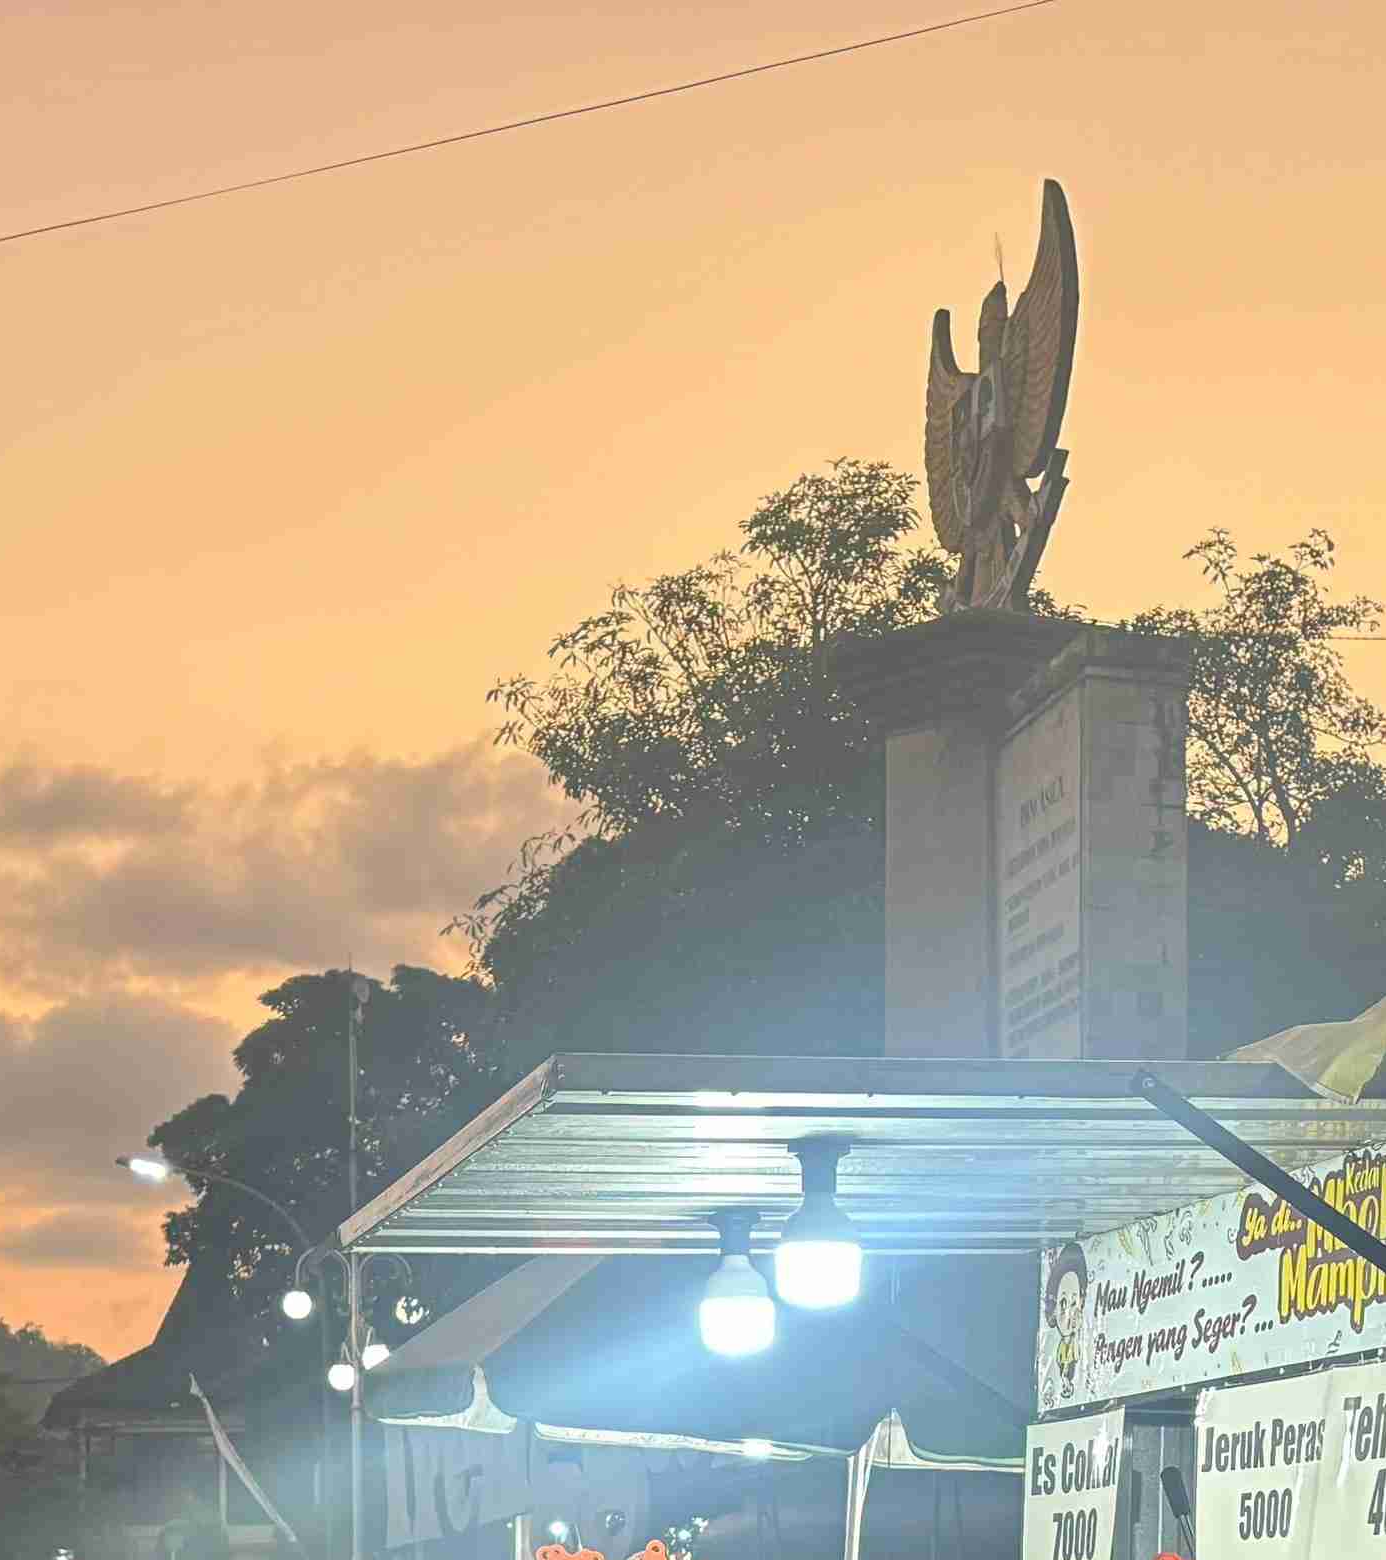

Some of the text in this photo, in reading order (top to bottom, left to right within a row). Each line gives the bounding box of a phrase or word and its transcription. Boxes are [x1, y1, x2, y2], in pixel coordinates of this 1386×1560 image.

[1346, 1159, 1381, 1195] Kedai
[1094, 1280, 1127, 1317] Mau
[1130, 1259, 1186, 1315] Ngemil
[1147, 1324, 1188, 1366] yang
[1031, 1437, 1119, 1496] Es Coka
[1201, 1418, 1326, 1473] Jeruk Peras
[1238, 1488, 1293, 1541] 5000
